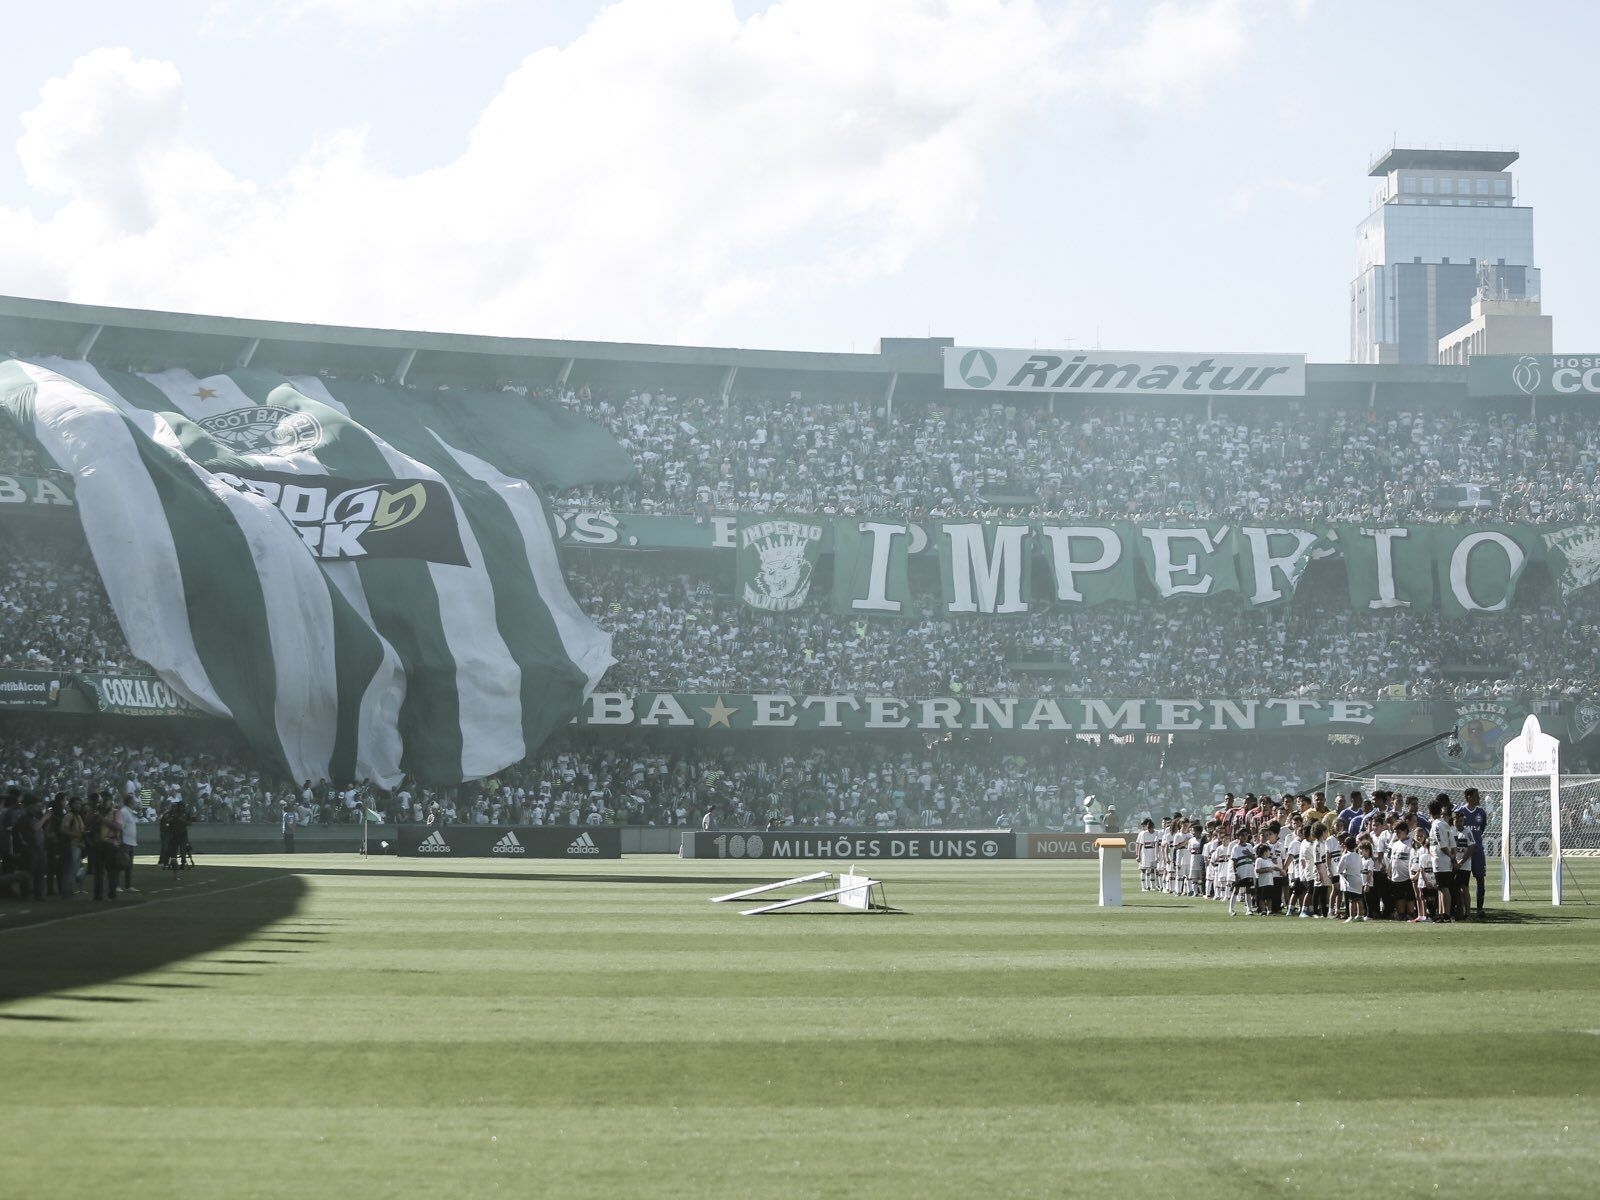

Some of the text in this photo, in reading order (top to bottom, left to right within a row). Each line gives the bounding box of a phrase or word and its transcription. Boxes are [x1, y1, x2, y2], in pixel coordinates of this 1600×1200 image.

[1006, 354, 1290, 391] Rimatur
[205, 410, 252, 430] FOOT
[0, 476, 74, 506] BA
[569, 692, 1375, 731] BA ETERNAMENTE
[418, 844, 450, 853] adidas
[492, 844, 525, 854] adidas
[566, 845, 600, 854] adidas
[713, 834, 977, 858] 100 MILHÕES DE UNS
[1037, 841, 1077, 853] NOVA
